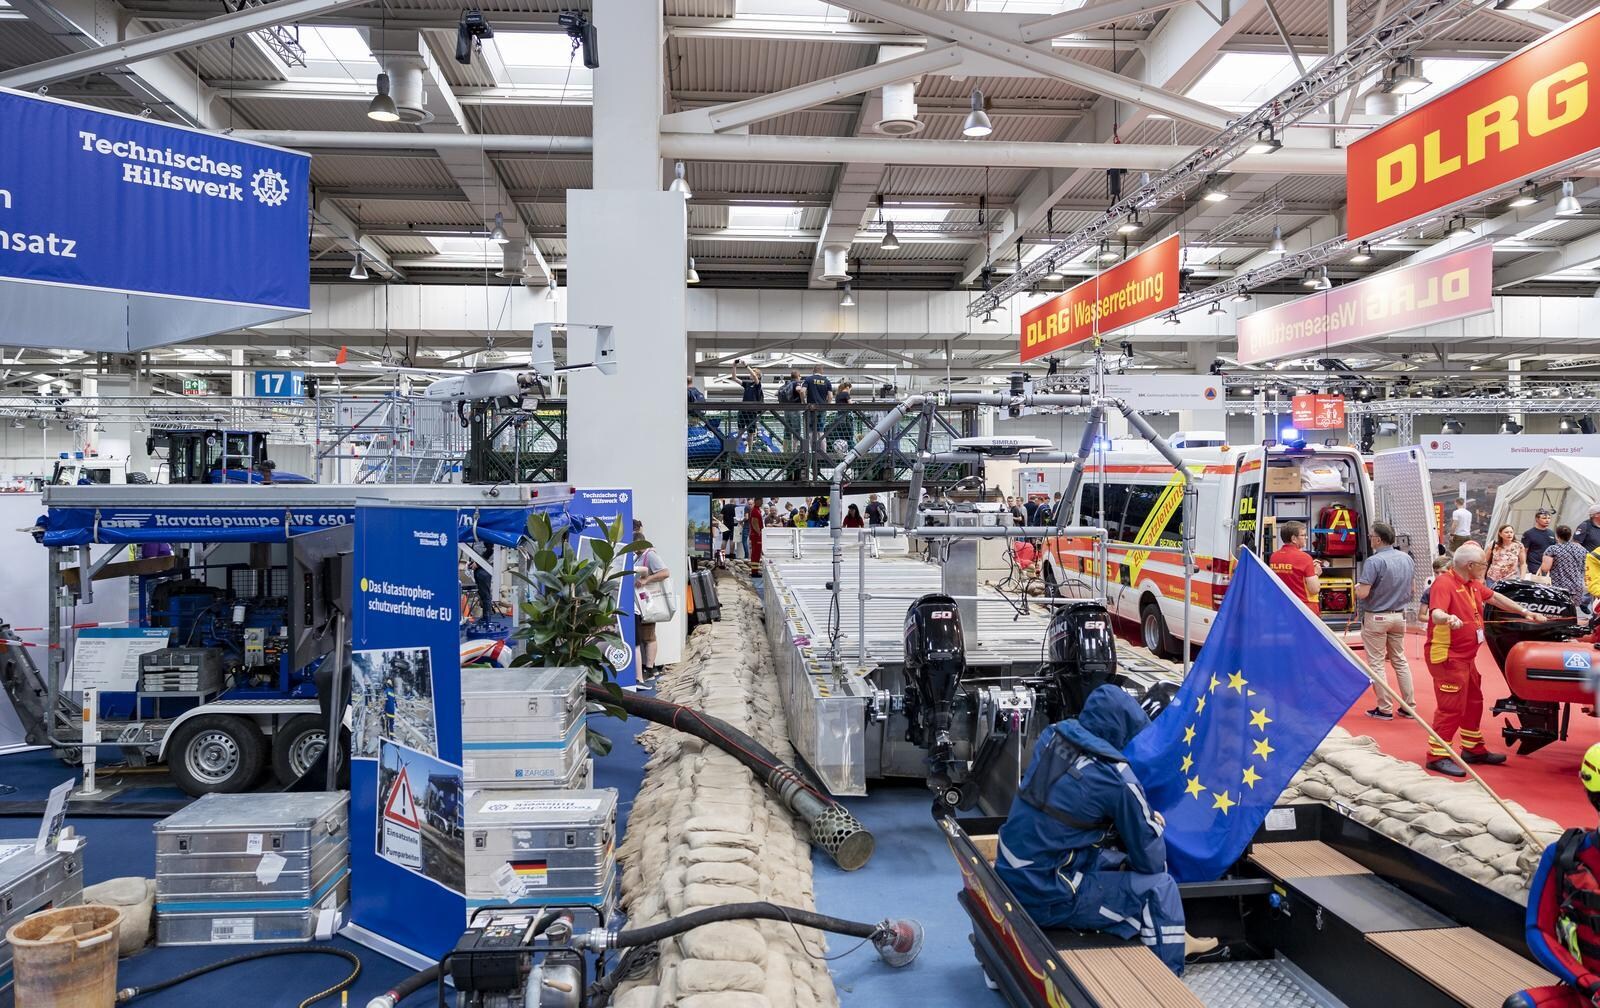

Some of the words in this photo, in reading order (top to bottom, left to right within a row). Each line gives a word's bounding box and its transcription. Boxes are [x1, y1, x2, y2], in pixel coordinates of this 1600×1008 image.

[1376, 60, 1589, 204] DLRG
[79, 130, 243, 179] Technisches
[122, 163, 243, 202] Hilfswerk
[1027, 307, 1070, 348] DLRG
[1074, 271, 1164, 328] Wasserrettung
[261, 373, 285, 394] 17
[293, 374, 303, 395] 17
[1510, 446, 1569, 455] Bevölkerungsschutz
[155, 514, 280, 529] Havariepumpe
[319, 514, 346, 526] 650
[368, 579, 382, 593] Das
[382, 581, 435, 601] Katastrophen-
[368, 597, 425, 618] schutzverfahren
[426, 605, 439, 620] der
[439, 607, 452, 622] EU
[931, 611, 953, 619] 60
[1516, 601, 1567, 614] RCURY
[1084, 621, 1106, 630] 60
[524, 768, 556, 777] ZARGES
